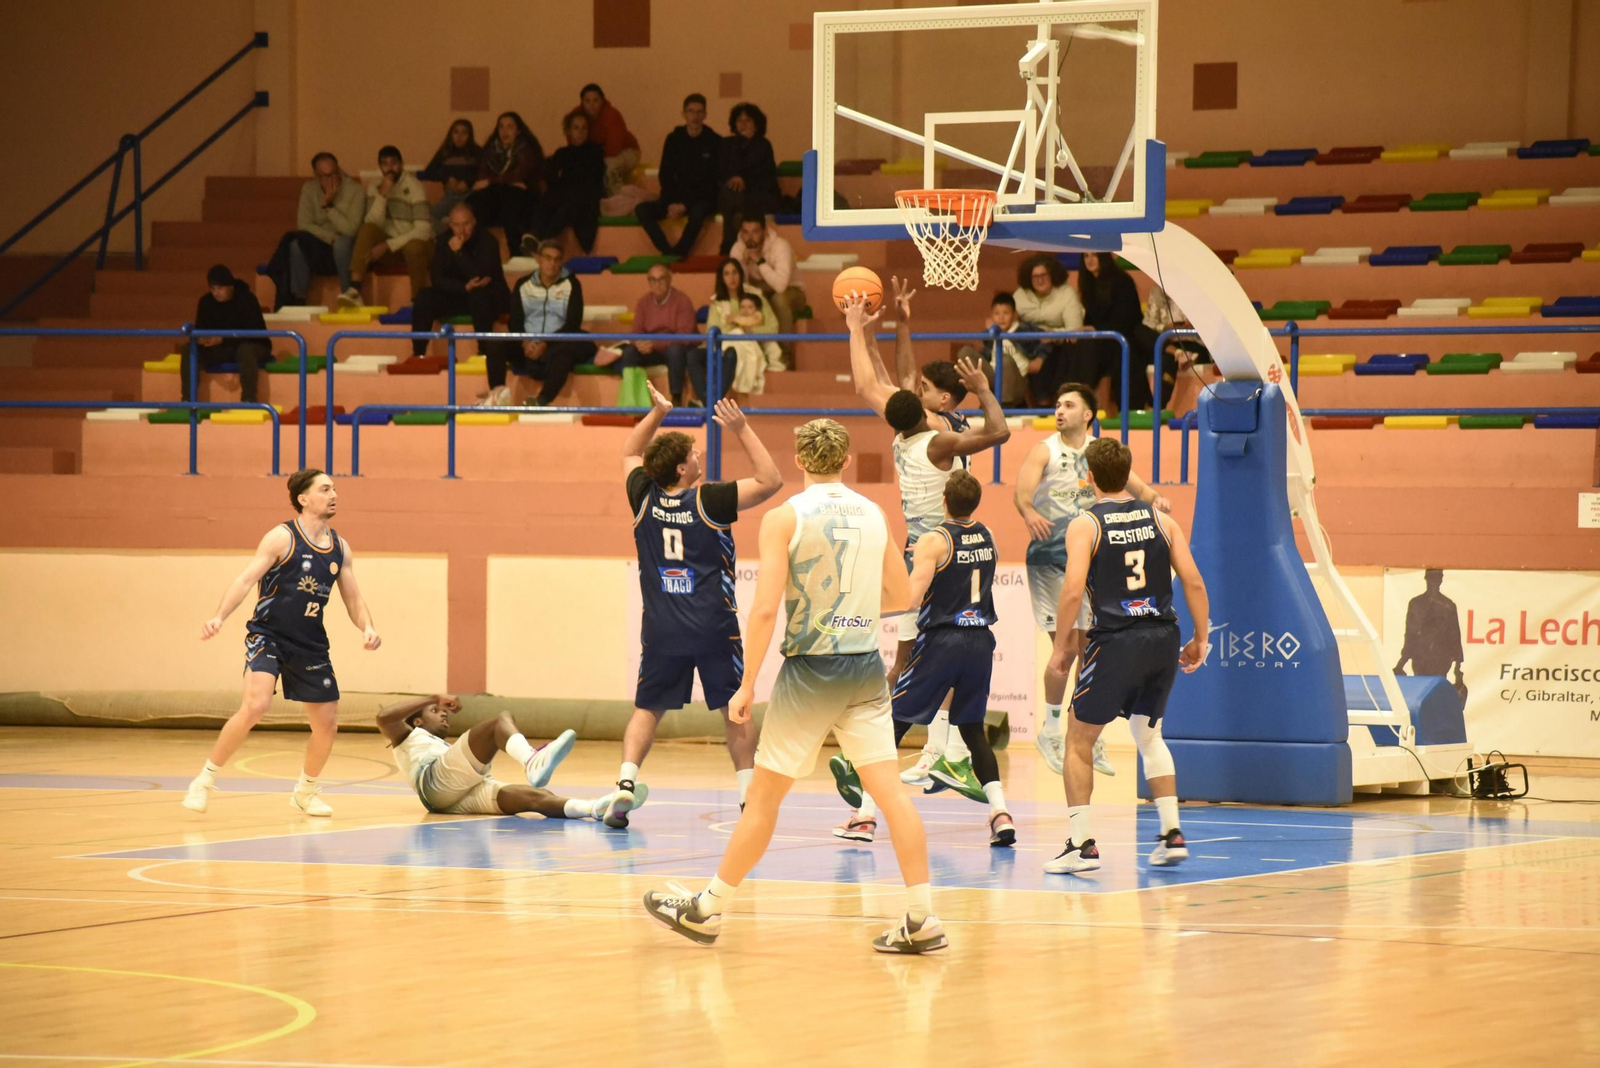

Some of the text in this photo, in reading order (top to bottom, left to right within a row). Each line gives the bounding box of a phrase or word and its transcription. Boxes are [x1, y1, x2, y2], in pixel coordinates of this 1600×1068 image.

[666, 510, 694, 524] STROG
[662, 527, 685, 561] 0
[1126, 525, 1155, 543] STROG
[831, 527, 862, 594] 7
[1124, 549, 1147, 591] 3
[970, 568, 981, 604] 1
[304, 601, 320, 618] 12
[831, 615, 872, 628] FitoSur
[1466, 609, 1600, 646] La Lech
[1220, 631, 1301, 660] IBERO
[1220, 660, 1301, 669] SPORT
[1525, 690, 1595, 705] Gibraltar,
